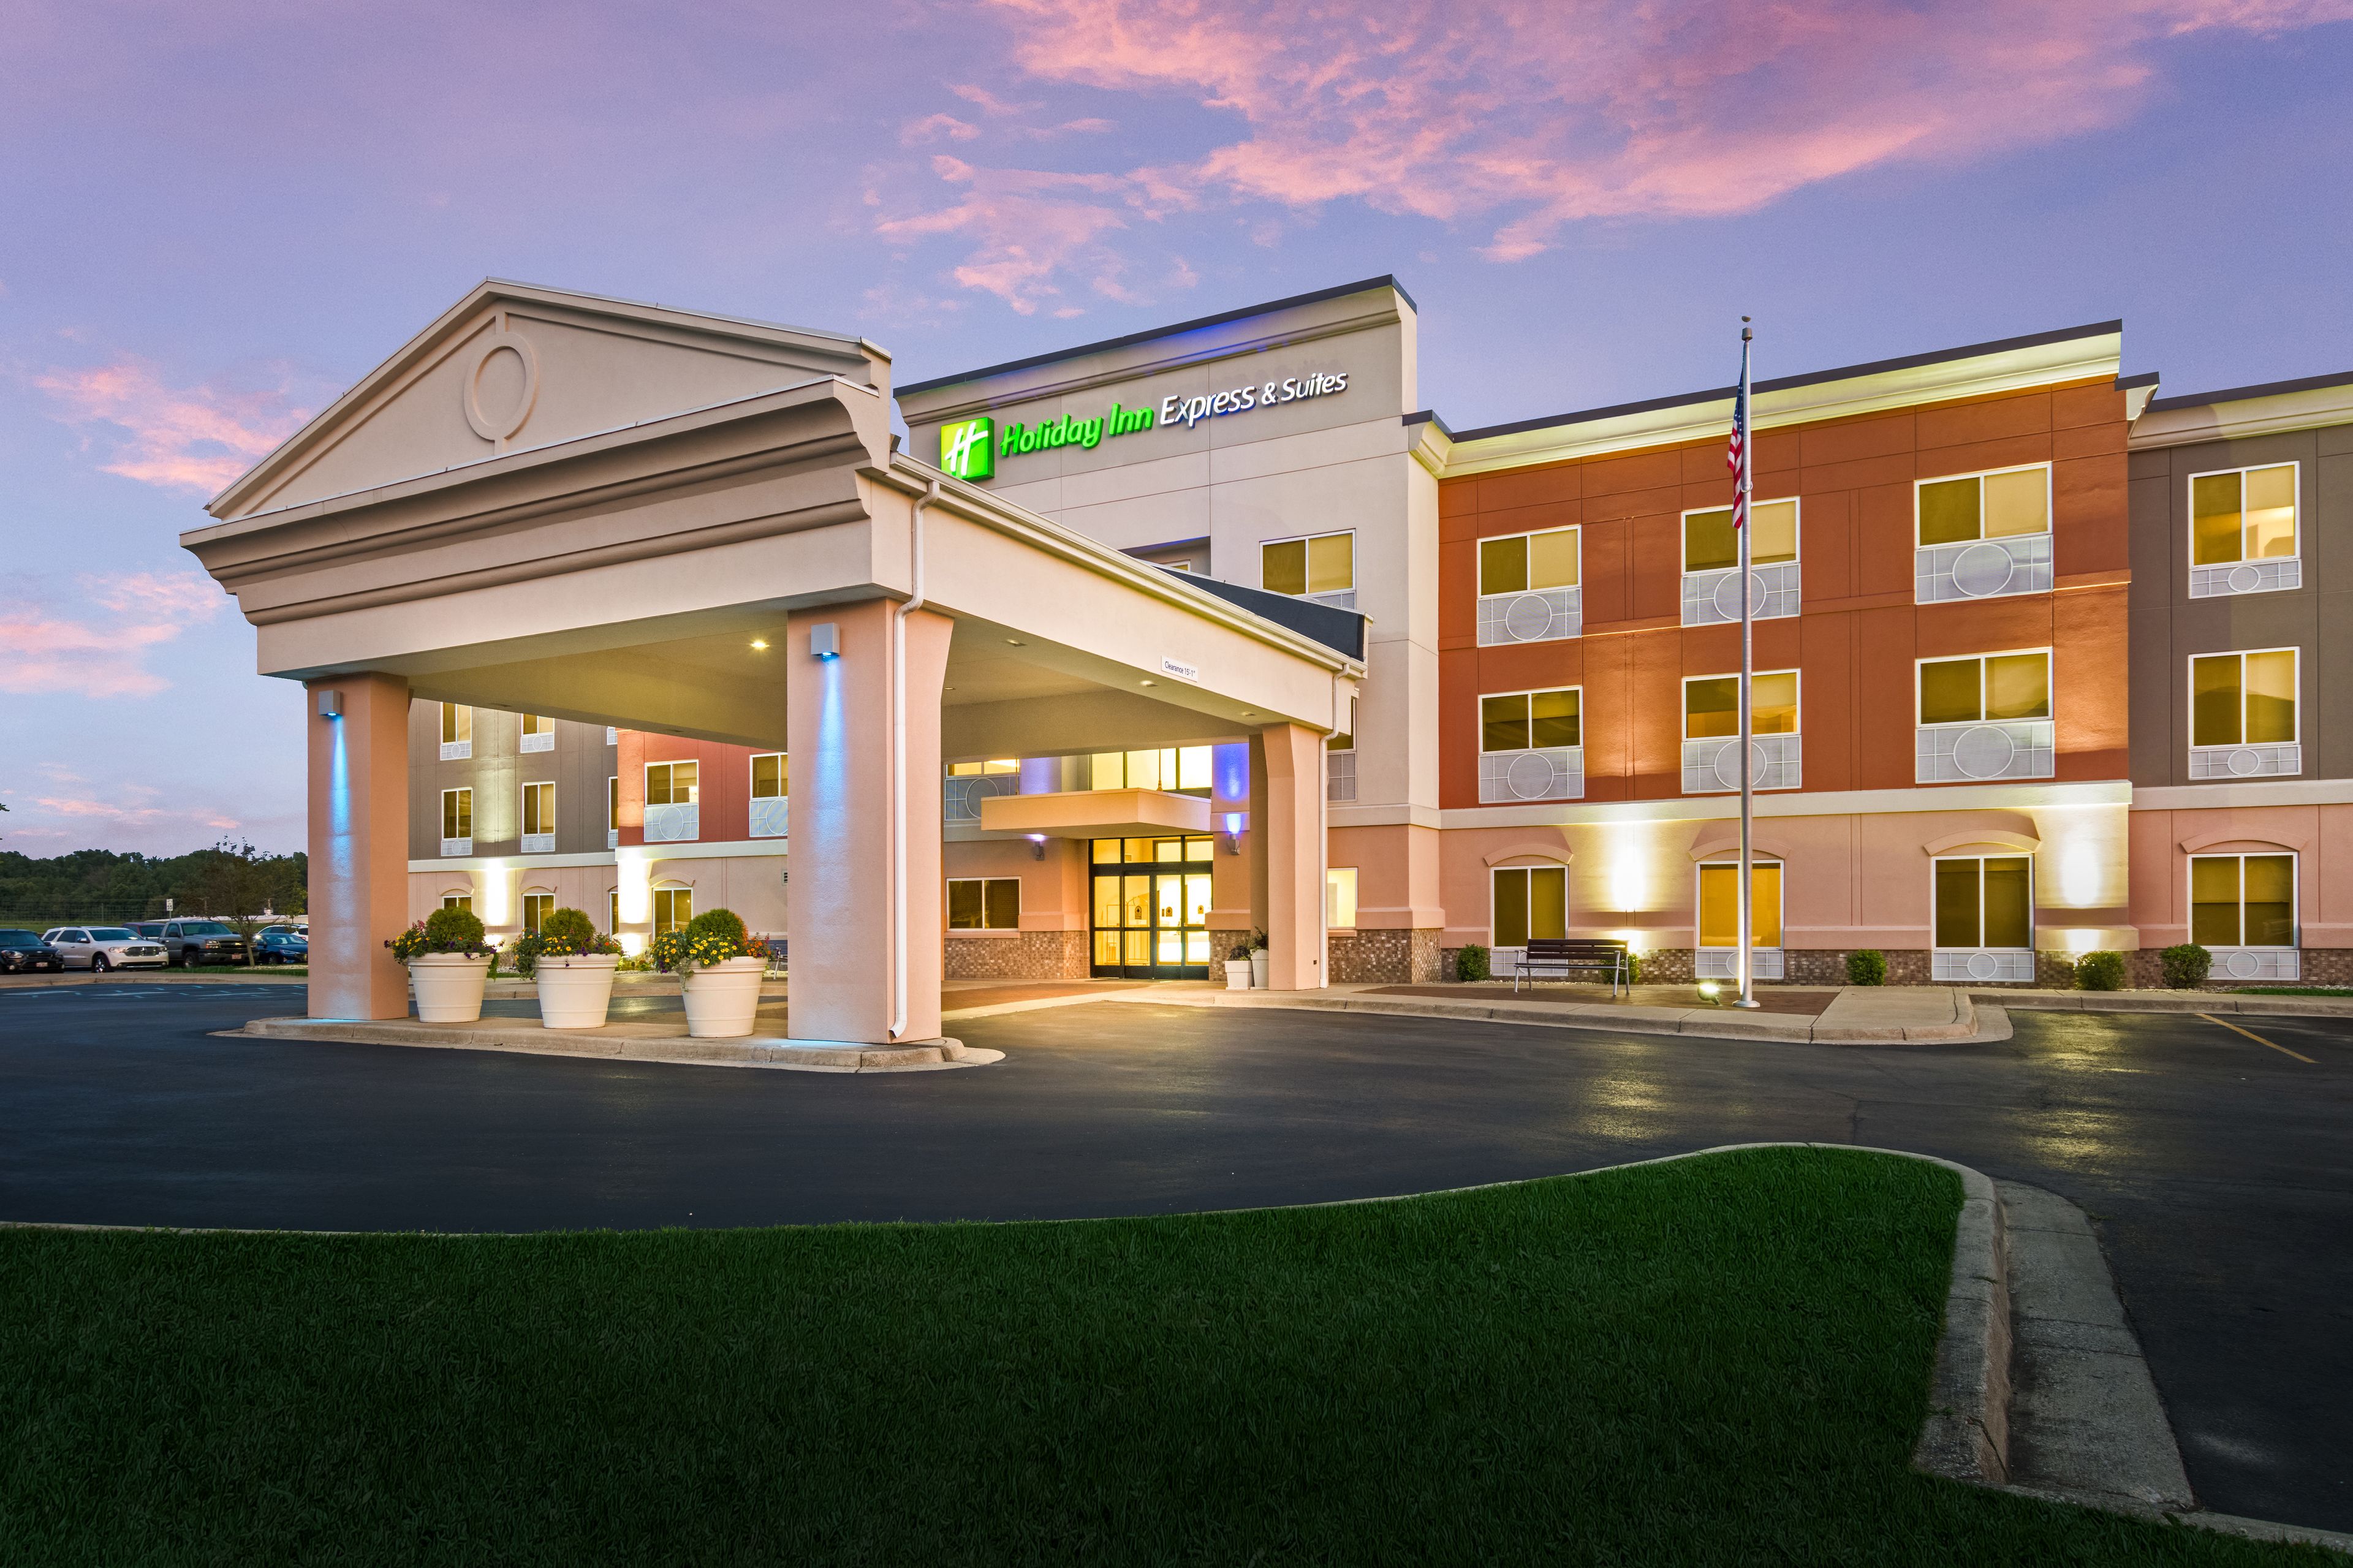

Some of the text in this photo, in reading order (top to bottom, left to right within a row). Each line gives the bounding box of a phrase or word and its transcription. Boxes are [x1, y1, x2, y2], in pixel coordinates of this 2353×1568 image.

[1000, 372, 1349, 456] Holiday Inn Express & Suites
[1164, 661, 1184, 674] Clearance
